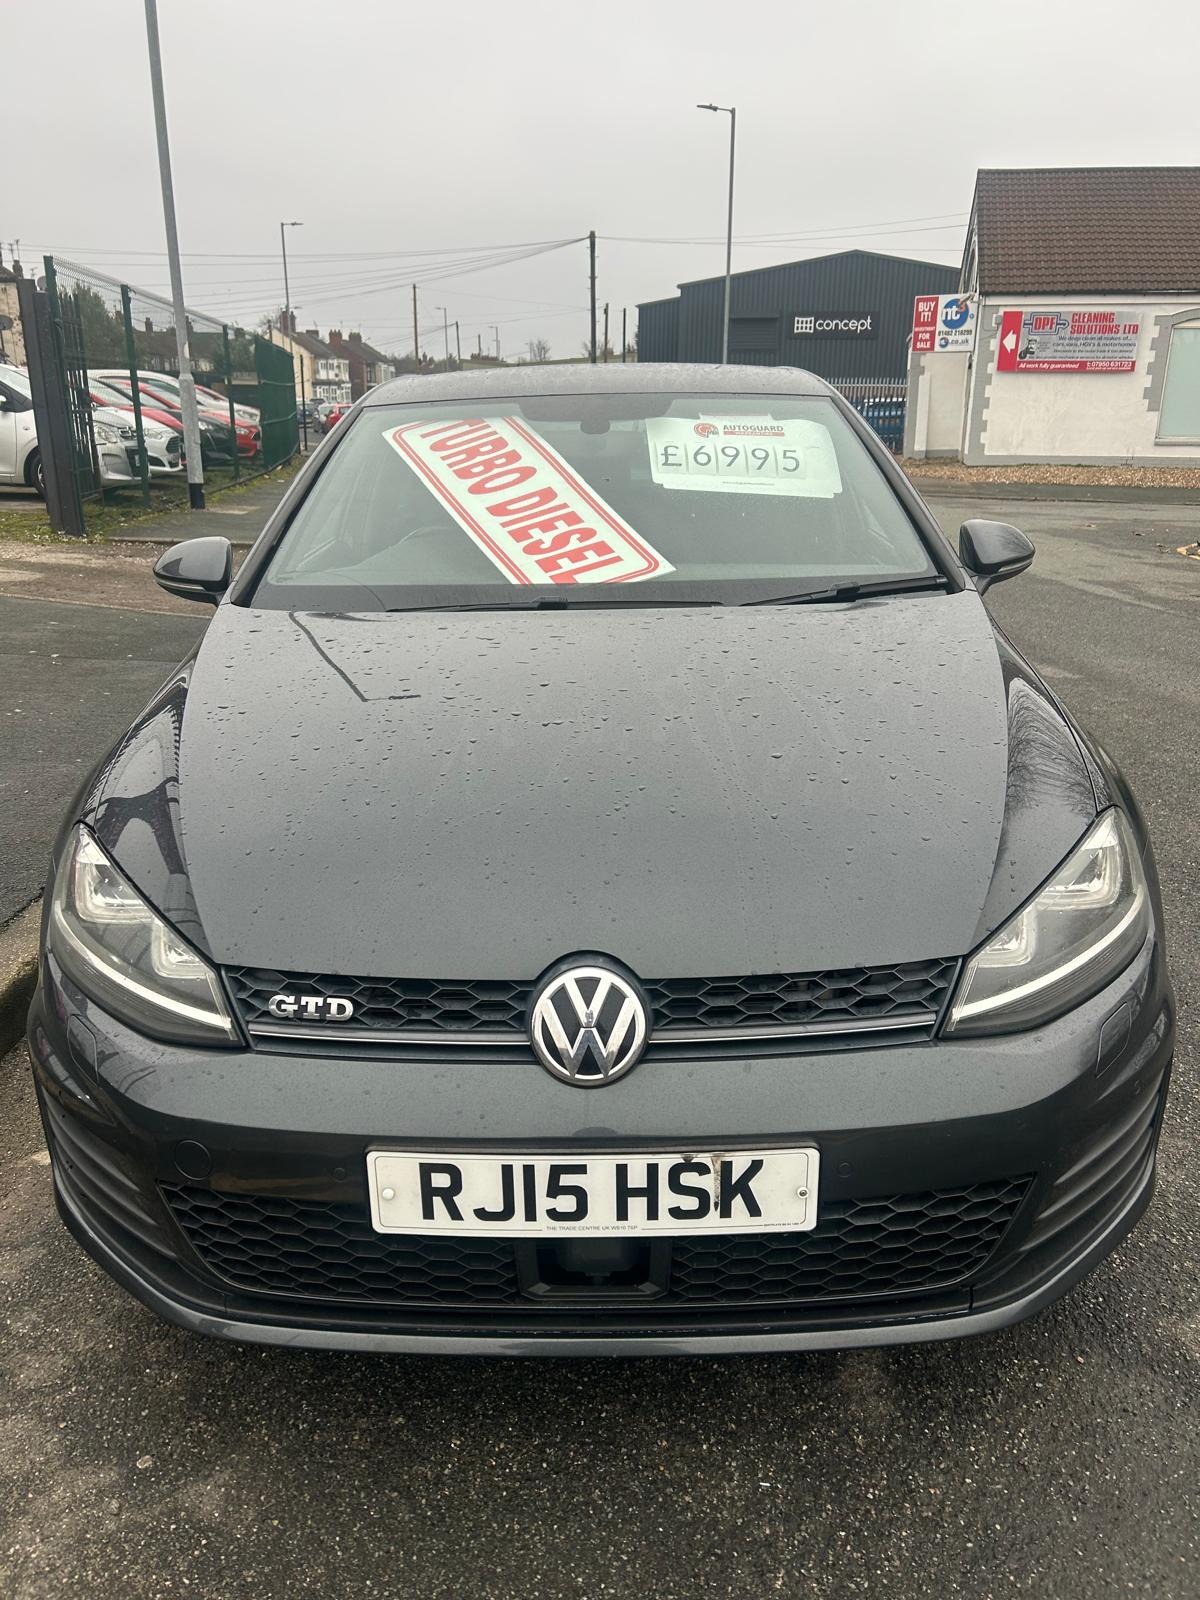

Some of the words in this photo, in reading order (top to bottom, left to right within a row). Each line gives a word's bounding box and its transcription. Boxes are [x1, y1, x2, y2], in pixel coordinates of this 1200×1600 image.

[918, 301, 936, 312] BUY
[920, 312, 931, 322] IT!
[1071, 312, 1116, 324] CLEANING
[815, 315, 872, 334] concept
[1034, 317, 1057, 331] DPF
[1070, 324, 1121, 335] SOLUTIONS
[1122, 324, 1139, 335] LTD
[916, 341, 931, 349] SALE
[723, 424, 784, 432] AUTOGUARD
[660, 444, 801, 473] £6995
[420, 418, 537, 495] TURBO
[485, 486, 624, 585] DIESEL
[268, 994, 354, 1021] GTD
[418, 1161, 589, 1222] RJ15
[615, 1159, 765, 1221] HSK
